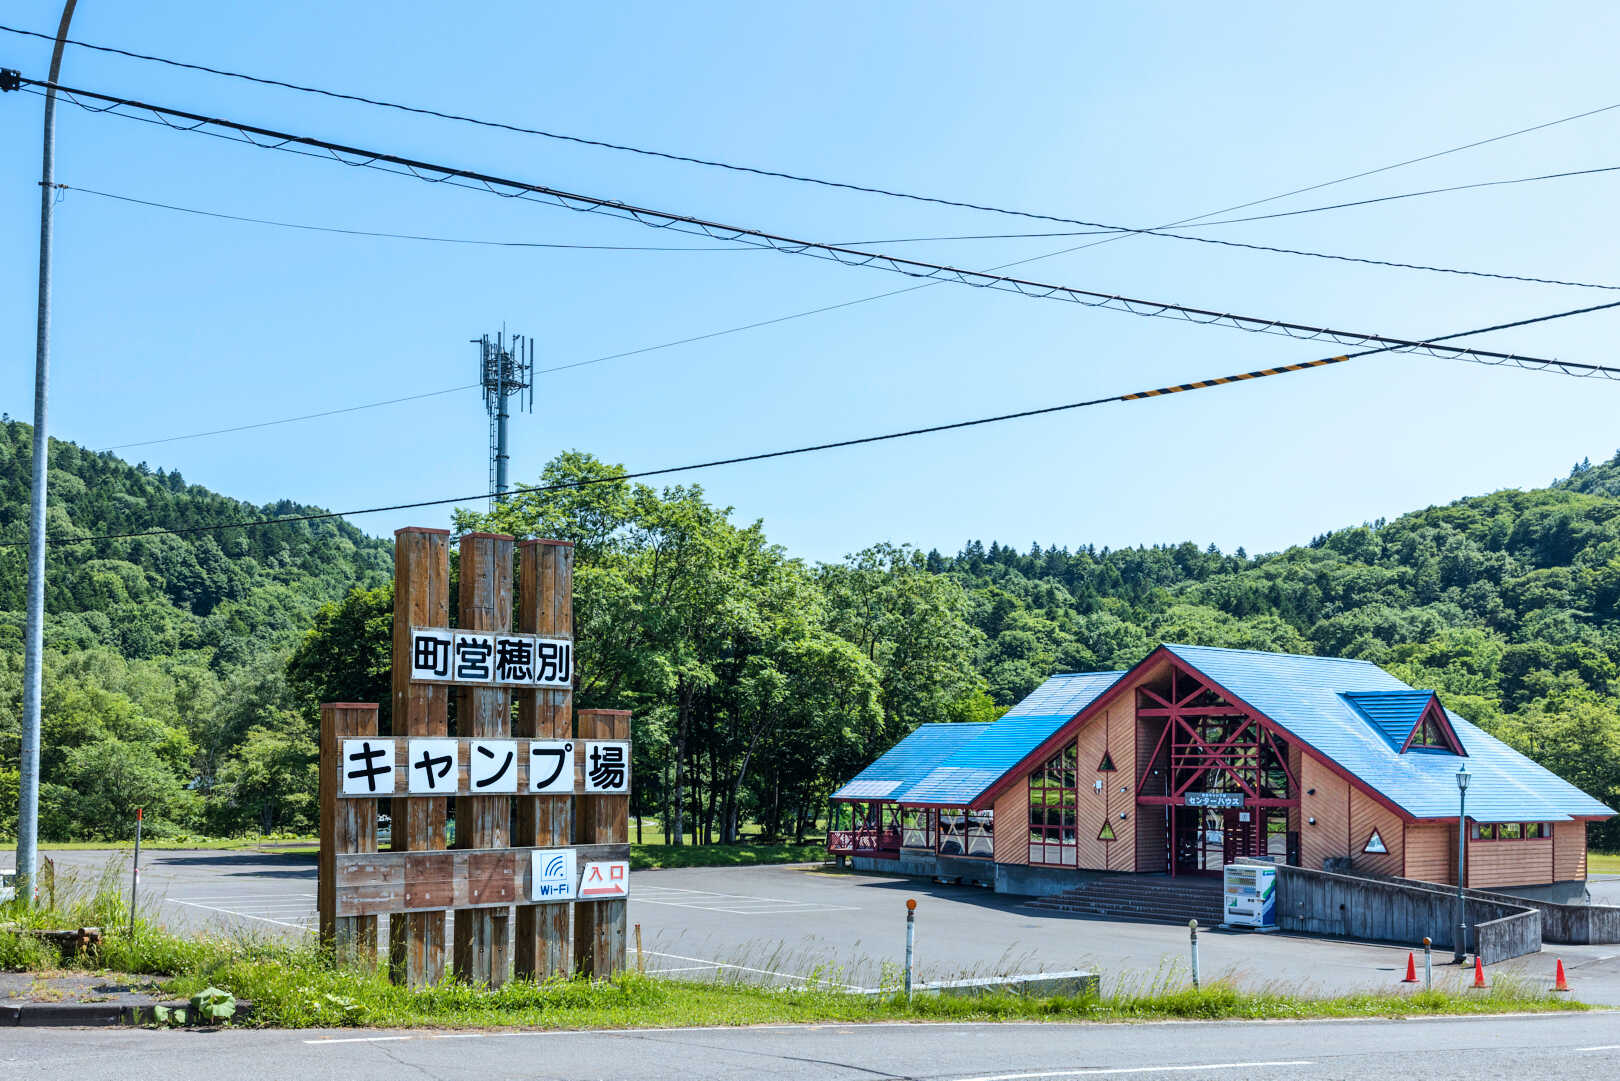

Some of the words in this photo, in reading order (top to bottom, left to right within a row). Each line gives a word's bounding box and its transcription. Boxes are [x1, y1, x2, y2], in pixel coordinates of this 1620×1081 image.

[414, 635, 570, 683] 町営穂別
[347, 742, 626, 792] キャンプ場
[1189, 796, 1240, 805] センターハウス
[588, 865, 624, 882] 入口
[540, 883, 569, 896] Wi-Fi
